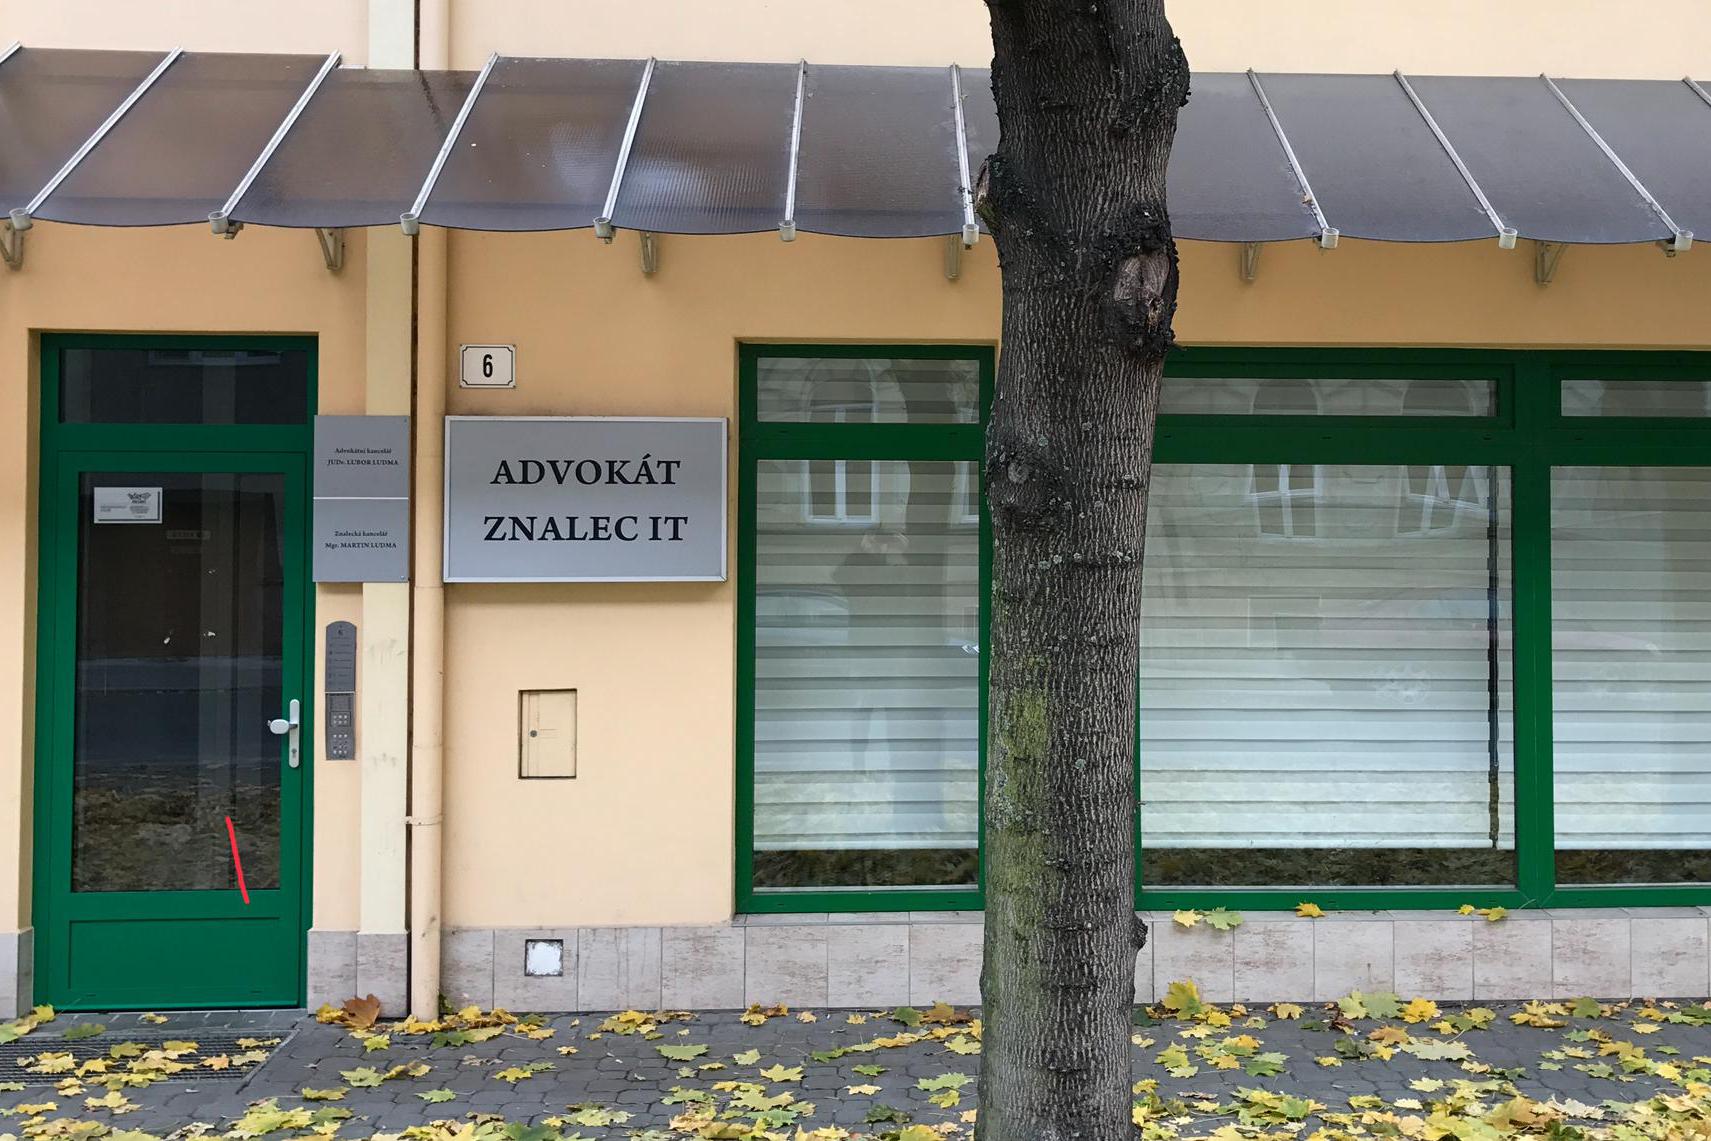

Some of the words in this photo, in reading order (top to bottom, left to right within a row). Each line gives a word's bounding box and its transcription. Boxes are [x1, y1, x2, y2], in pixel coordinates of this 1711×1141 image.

[483, 354, 493, 378] 6
[490, 453, 681, 485] ADVOKÁT
[484, 516, 638, 541] ZNALEC
[648, 516, 689, 541] IT
